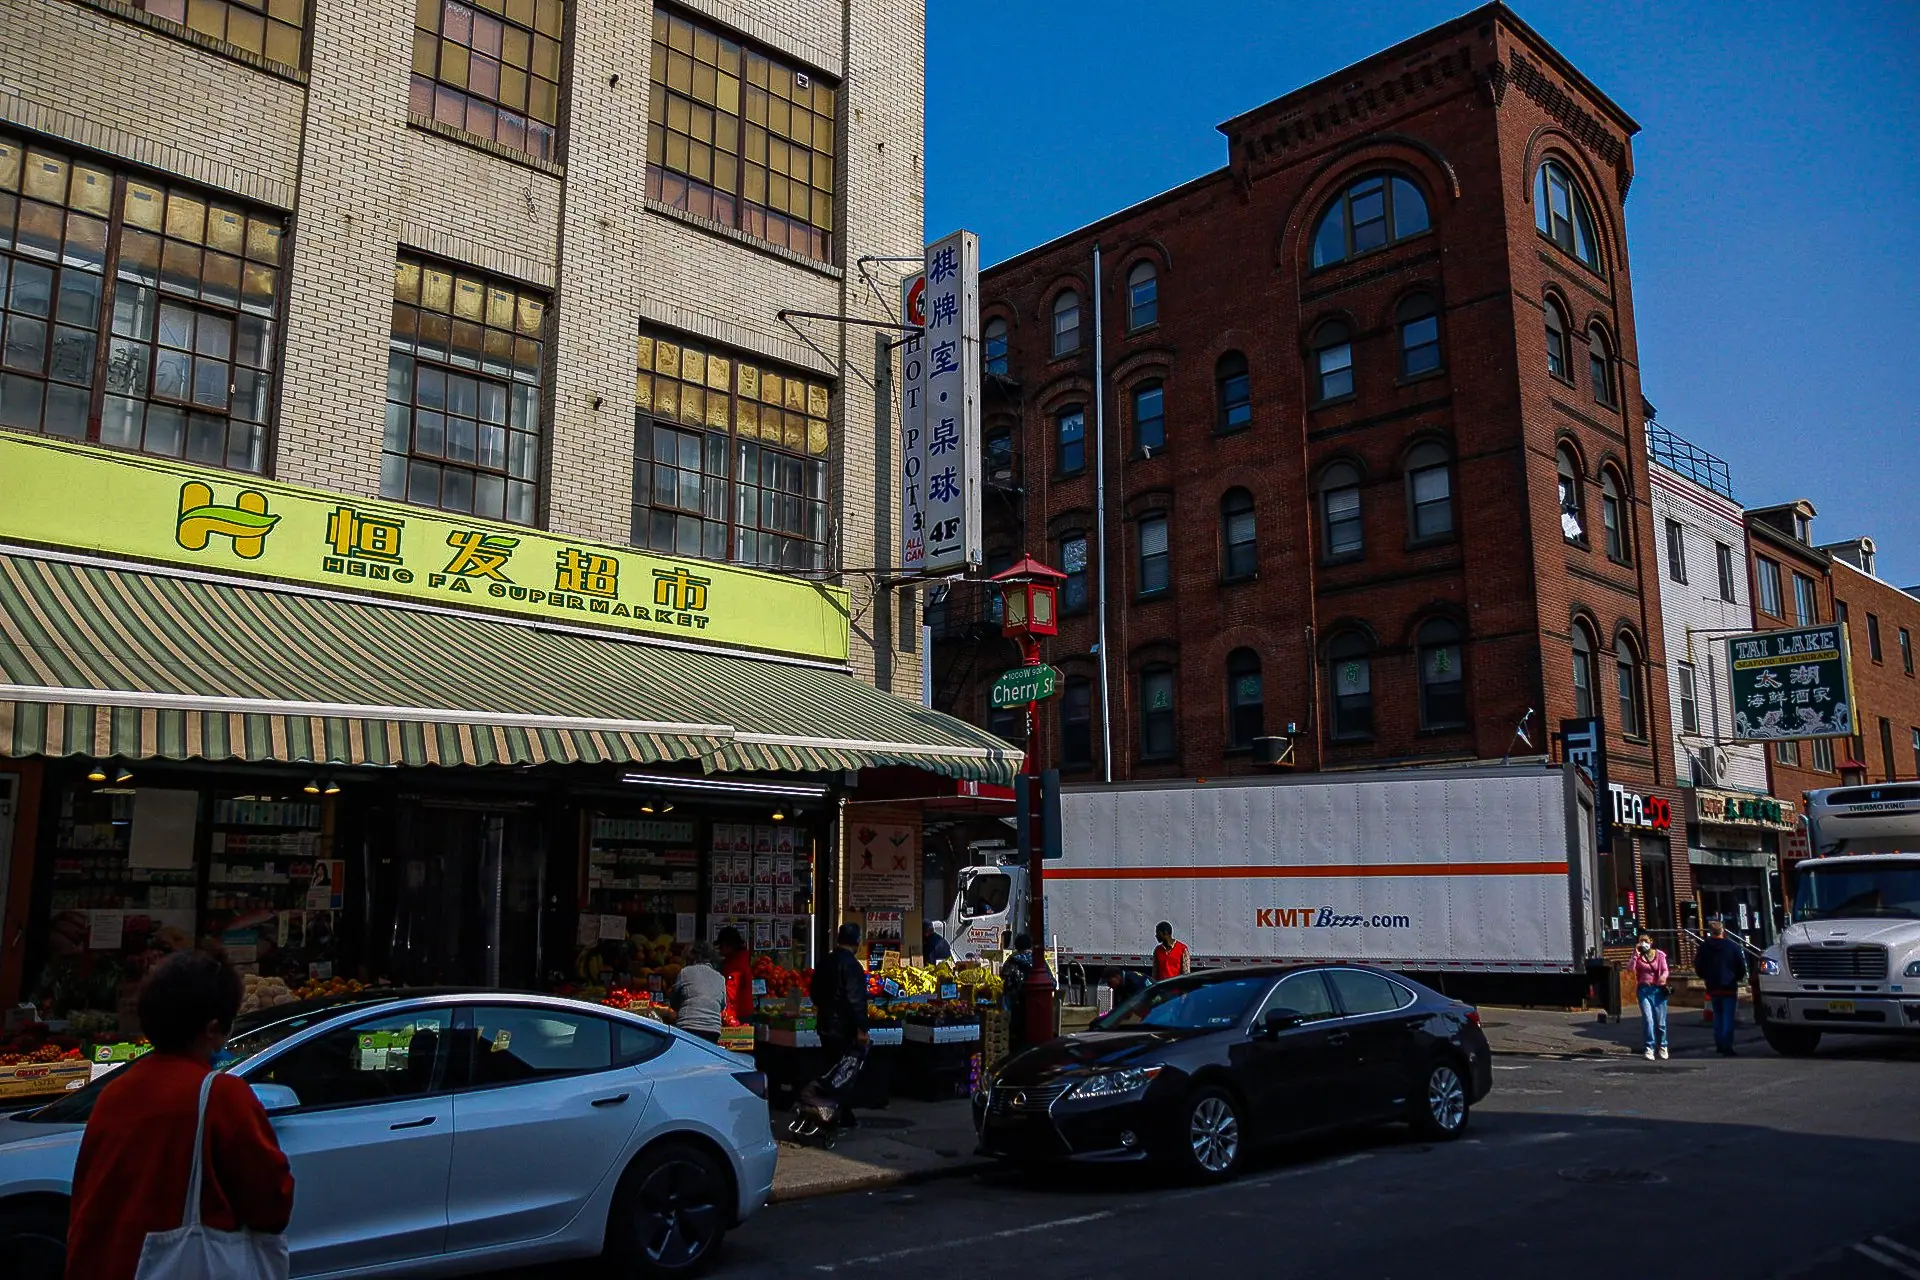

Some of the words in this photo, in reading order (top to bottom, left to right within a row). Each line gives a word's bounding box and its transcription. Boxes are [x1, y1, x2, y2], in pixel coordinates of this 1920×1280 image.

[906, 333, 922, 409] HOT
[904, 428, 921, 507] POT
[911, 511, 926, 532] 3
[928, 516, 960, 544] 4F
[905, 538, 923, 551] ALL
[905, 549, 925, 562] CAN
[325, 506, 711, 612] 恒发超市
[323, 556, 414, 584] HENG
[428, 573, 473, 593] FA
[488, 583, 710, 629] SUPERMARKET
[1736, 640, 1768, 659] TAI
[1777, 631, 1835, 654] LAKE
[1738, 658, 1776, 668] SEAFOOD
[1779, 651, 1837, 664] RESTAURANT
[1754, 665, 1820, 688] 太湖
[993, 682, 1039, 703] Cherry
[1043, 677, 1054, 693] St
[1747, 686, 1831, 707] 海鮮酒家
[1847, 803, 1884, 812] THERMO
[1885, 802, 1906, 810] KING
